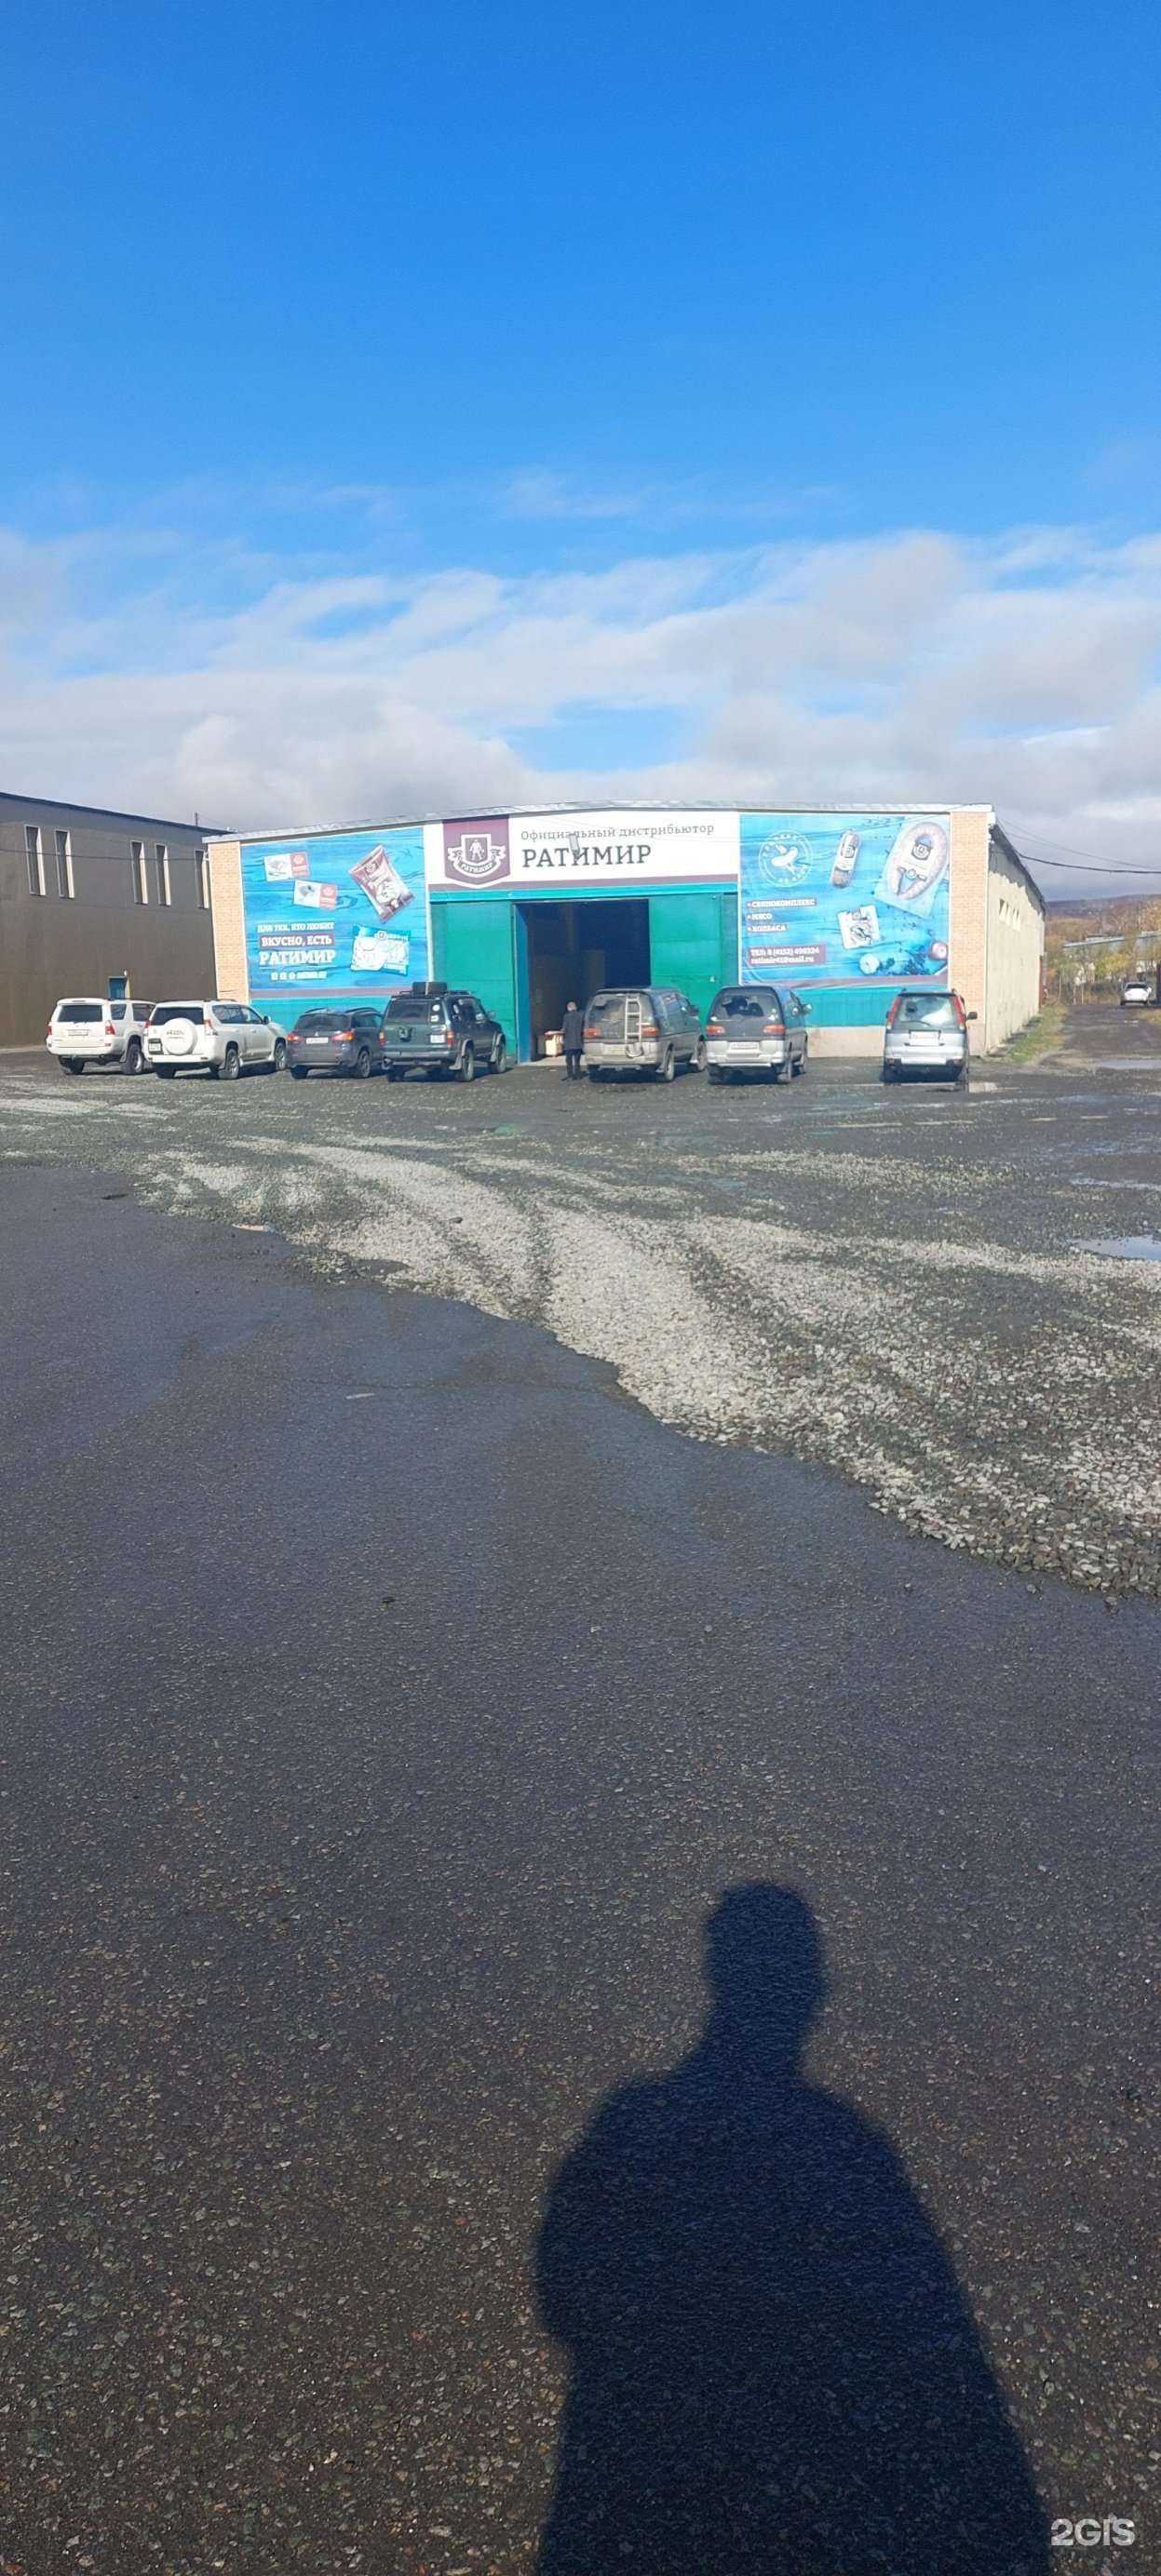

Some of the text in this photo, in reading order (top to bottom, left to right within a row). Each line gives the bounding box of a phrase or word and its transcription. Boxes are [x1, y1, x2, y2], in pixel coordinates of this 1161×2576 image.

[619, 825, 714, 838] дистрибьютор
[522, 844, 652, 867] РАТИМИР
[261, 935, 332, 946] ВКУСНО, ЕСТЬ
[259, 949, 336, 965] РАТИМИР
